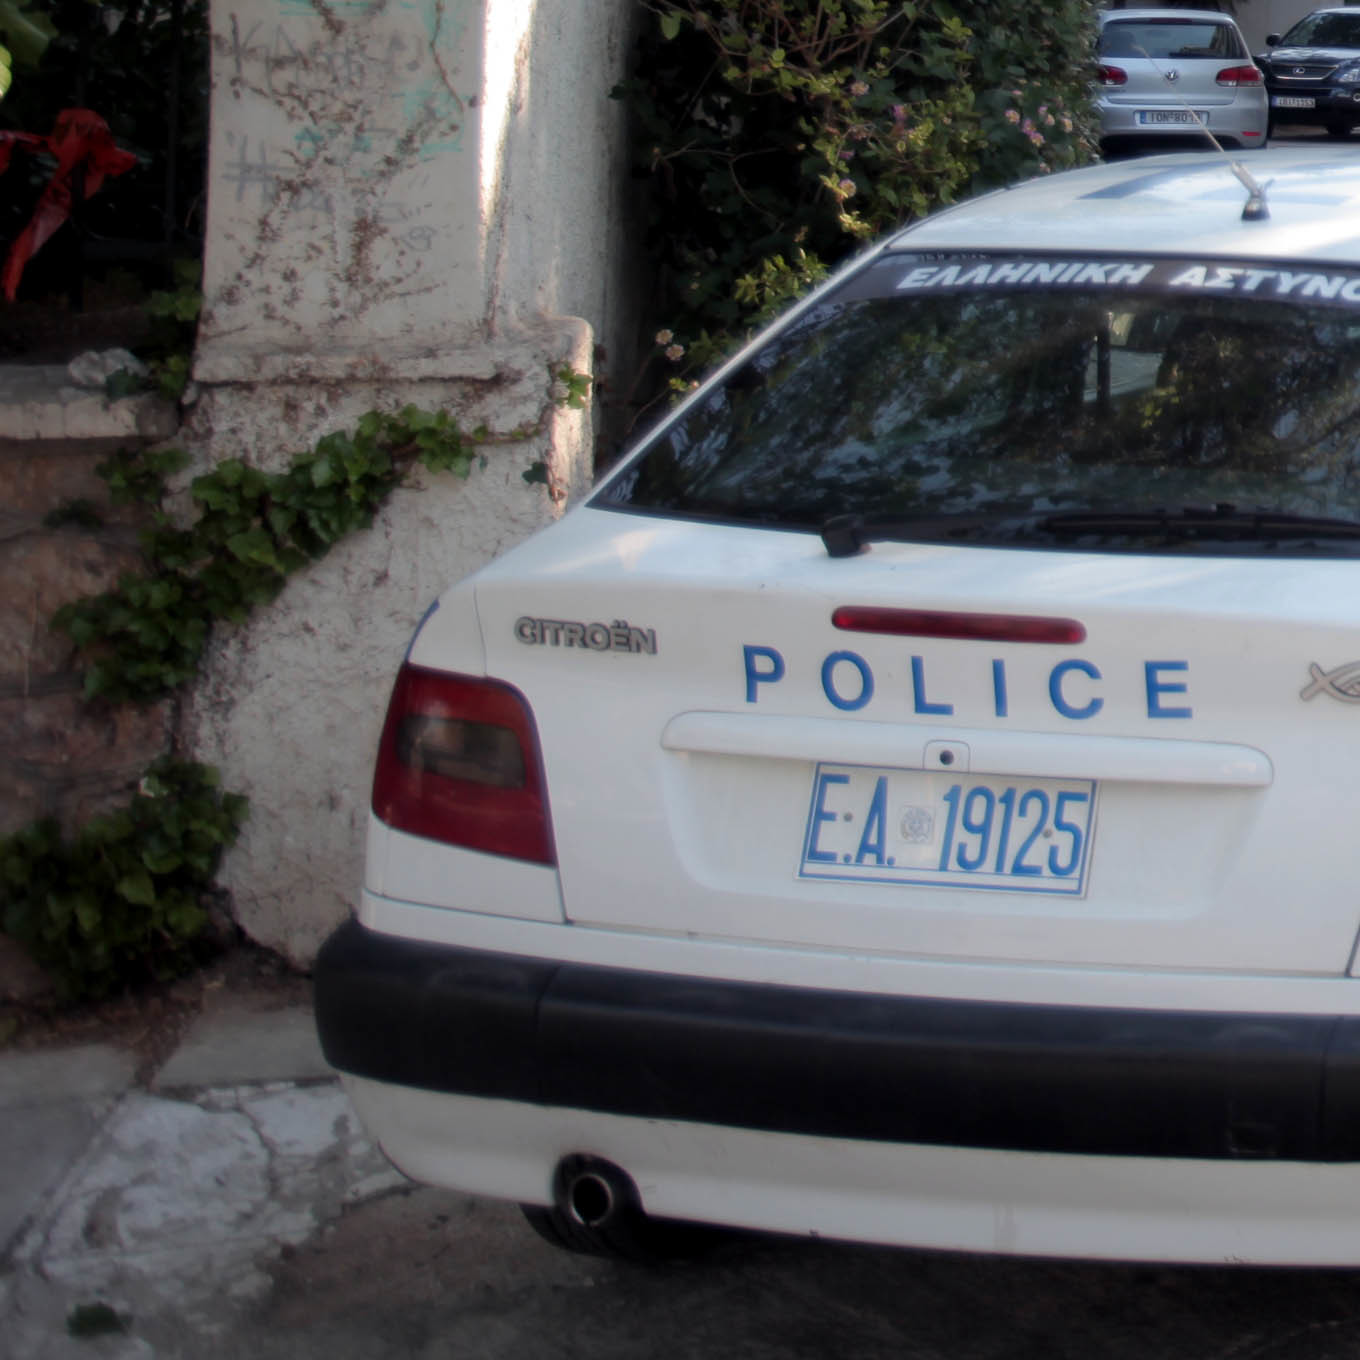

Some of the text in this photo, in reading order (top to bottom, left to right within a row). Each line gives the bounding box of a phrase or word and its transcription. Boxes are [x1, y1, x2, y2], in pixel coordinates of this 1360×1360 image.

[897, 262, 1155, 291] ΕΛΛΗΝΙΚΗ
[514, 616, 658, 655] CITROËN
[743, 644, 1194, 721] POLICE
[939, 784, 1089, 876] 19125
